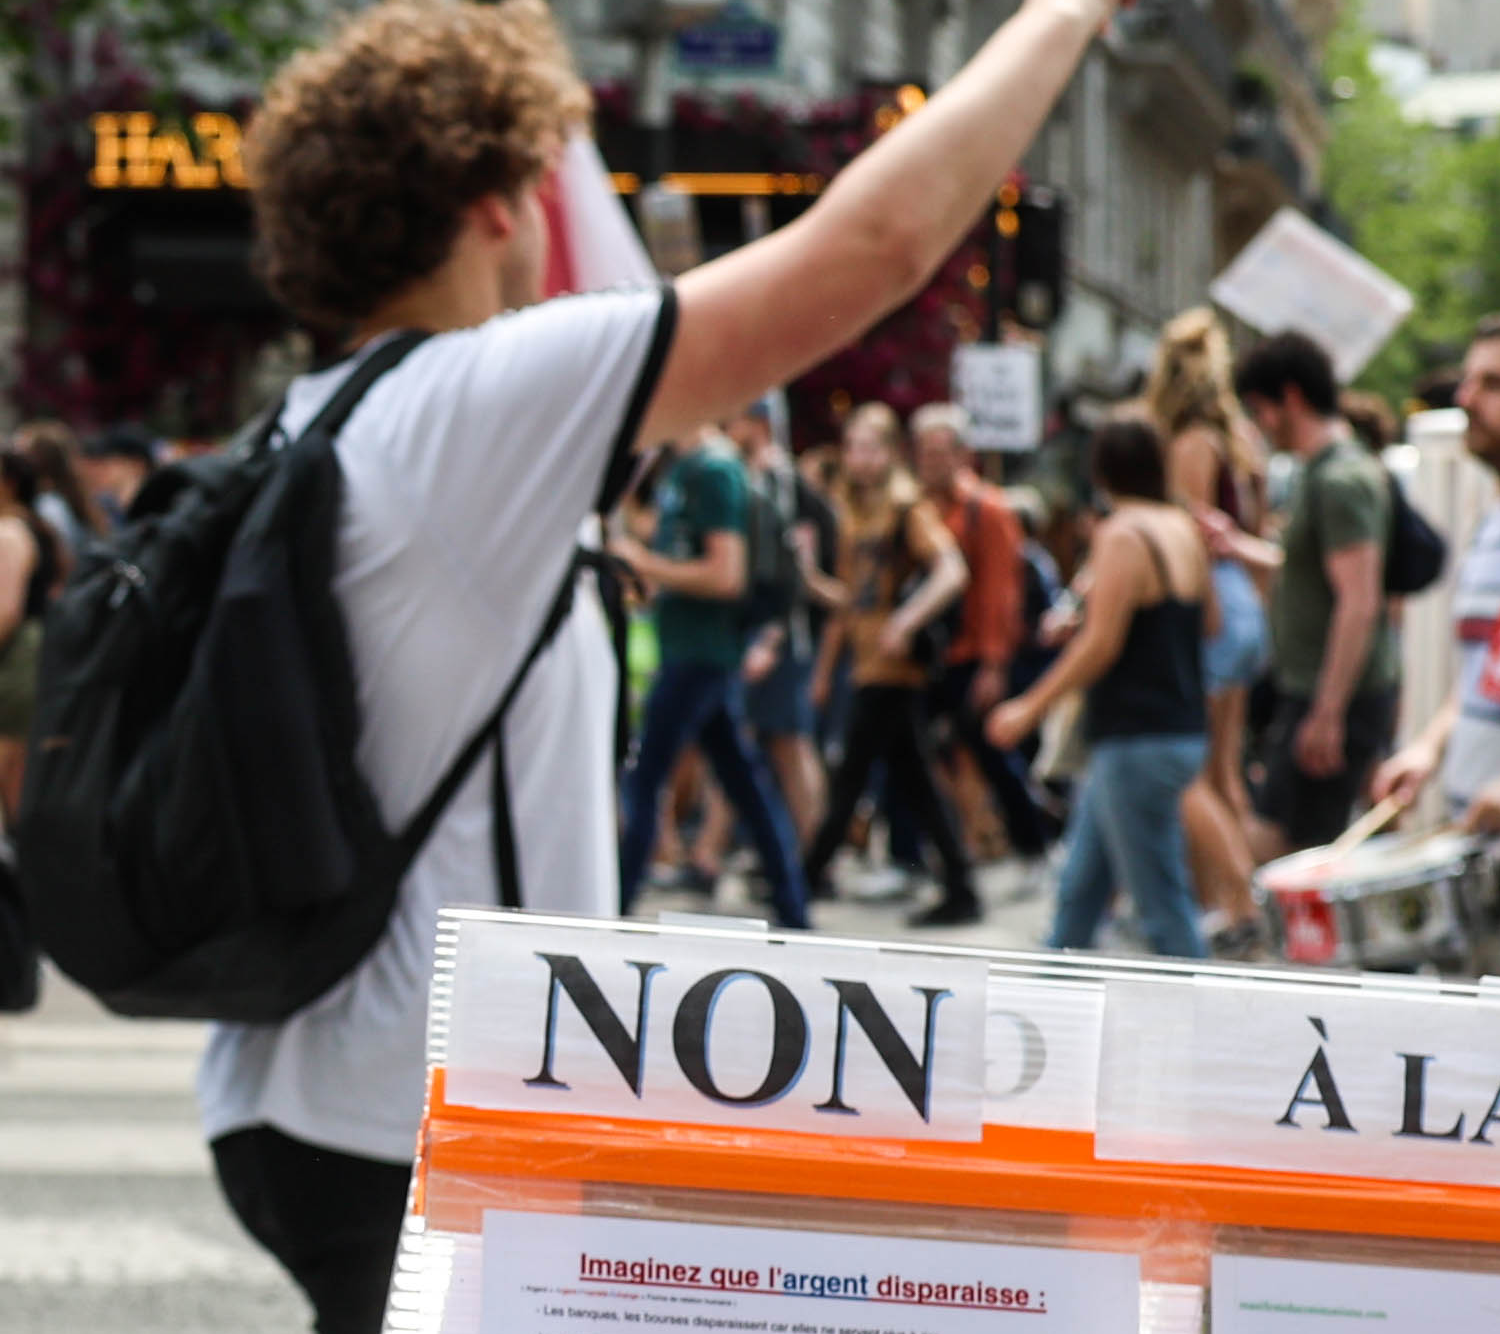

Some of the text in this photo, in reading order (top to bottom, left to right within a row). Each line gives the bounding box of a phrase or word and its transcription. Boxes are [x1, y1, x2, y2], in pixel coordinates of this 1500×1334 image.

[523, 950, 956, 1125] NON
[1274, 1015, 1358, 1133] À
[580, 1252, 702, 1285] Imaginez
[709, 1267, 760, 1293] que
[768, 1266, 869, 1300] l'argent
[876, 1274, 1030, 1308] disparaisse
